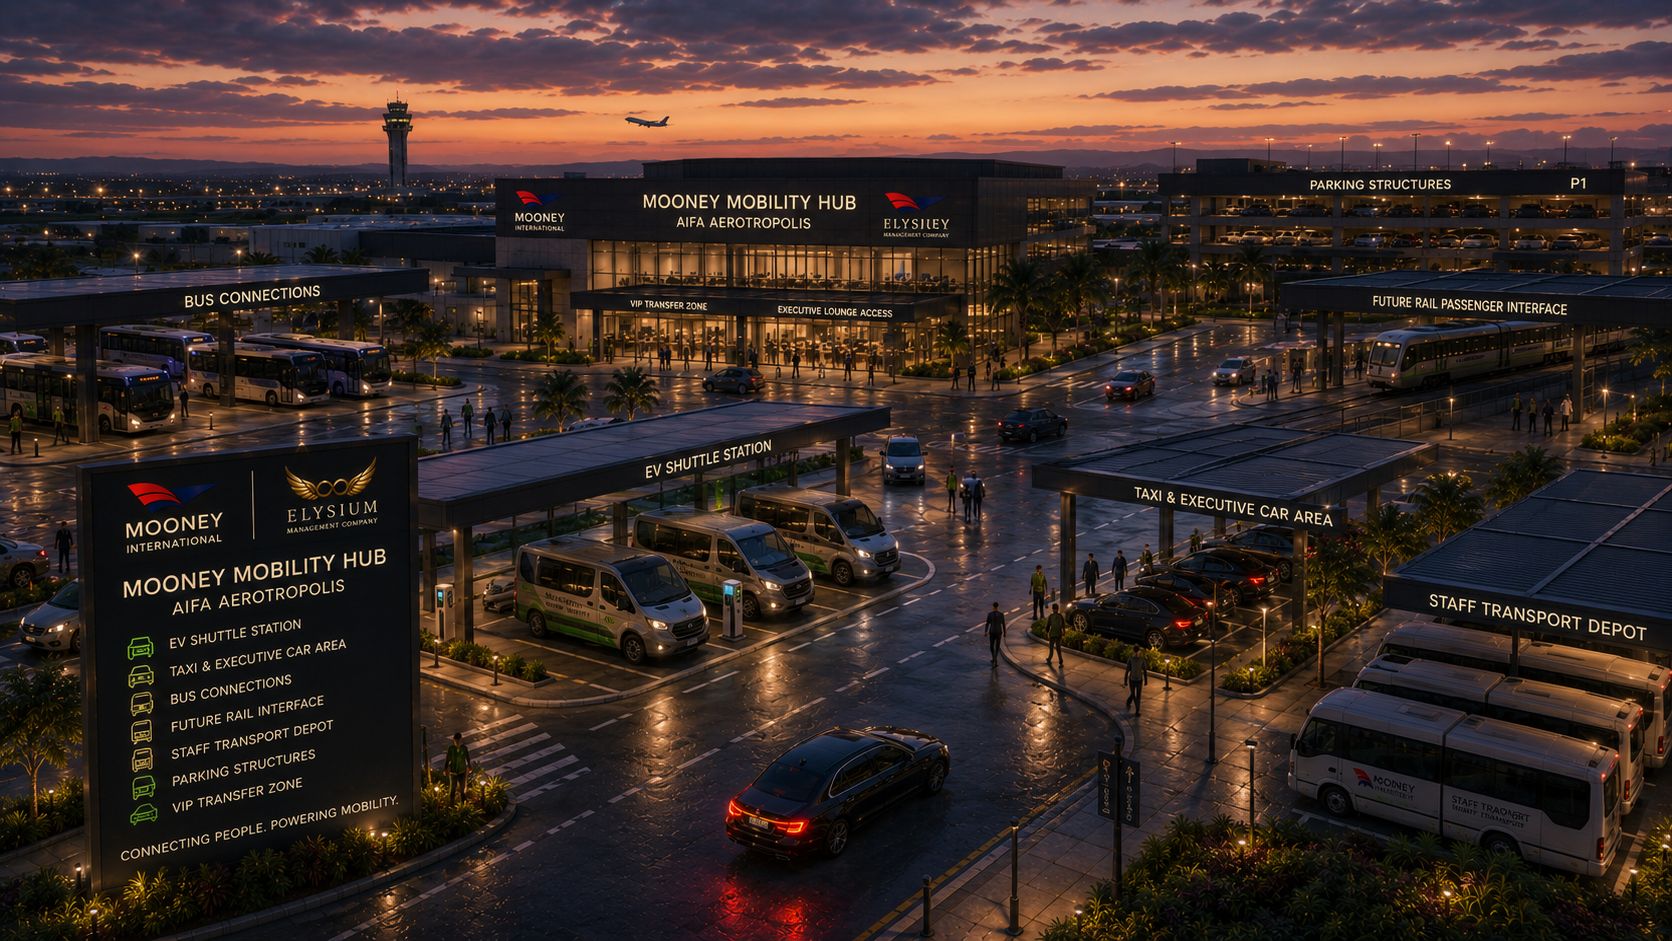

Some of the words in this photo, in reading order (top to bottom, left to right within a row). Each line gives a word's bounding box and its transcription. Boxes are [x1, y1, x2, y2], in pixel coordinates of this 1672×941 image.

[1310, 179, 1364, 190] PARKING
[1369, 179, 1451, 190] STRUCTURES
[1570, 177, 1586, 189] P1
[514, 212, 565, 223] MOONEY
[643, 194, 720, 209] MOONEY
[726, 194, 811, 210] MOBILITY
[818, 195, 857, 211] HUB
[676, 217, 704, 228] AIFA
[709, 217, 811, 229] AEROTROPOLIS
[185, 295, 214, 308] BUS
[219, 285, 321, 305] CONNECTIONS
[645, 300, 684, 309] TRANSFER
[777, 305, 822, 315] EXECUTIVE
[824, 307, 857, 316] LOUNGE
[860, 308, 893, 318] ACCESS
[1372, 295, 1411, 308] FUTURE
[1415, 298, 1438, 309] RAIL
[1441, 298, 1503, 312] PASSENGER
[1507, 302, 1568, 315] INTERFACE
[645, 465, 661, 479] EV
[665, 450, 720, 475] SHUTTLE
[723, 440, 773, 462] STATION
[287, 500, 378, 523] ELYSIUM
[1134, 486, 1162, 502] TAXI
[1167, 491, 1175, 504] &
[1180, 493, 1255, 516] EXECUTIVE
[1260, 504, 1289, 521] CAR
[1294, 510, 1333, 527] AREA
[125, 512, 223, 539] MOONEY
[126, 534, 222, 554] INTERNATIONAL
[123, 568, 225, 598] MOONEY
[234, 554, 335, 583] MOBILITY
[343, 548, 387, 569] HUB
[172, 597, 211, 615] AIFA
[219, 579, 345, 609] AEROTROPOLIS
[1429, 593, 1476, 613] STAFF
[1482, 602, 1582, 630] TRANSPORT
[1588, 618, 1647, 641] DEPOT
[169, 637, 186, 649] EV
[190, 627, 247, 647] SHUTTLE
[251, 618, 302, 638] STATION
[169, 663, 197, 677] TAXI
[202, 660, 211, 672] &
[215, 650, 283, 671] EXECUTIVE
[286, 645, 311, 658] CAR
[315, 638, 347, 653] AREA
[170, 692, 196, 705] BUS
[200, 674, 292, 700] CONNECTIONS
[171, 714, 222, 733] FUTURE
[226, 709, 254, 723] RAIL
[258, 695, 324, 717] INTERFACE
[171, 743, 210, 760] STAFF
[214, 729, 289, 751] TRANSPORT
[293, 719, 334, 737] DEPOT
[172, 766, 230, 787] PARKING
[233, 749, 316, 775] STRUCTURES
[172, 800, 194, 813] VIP
[197, 786, 265, 808] TRANSFER
[268, 777, 303, 792] ZONE
[120, 836, 210, 862] CONNECTING
[215, 822, 267, 841] PEOPLE.
[270, 807, 338, 830] POWERING
[341, 795, 399, 815] MOBILITY.
